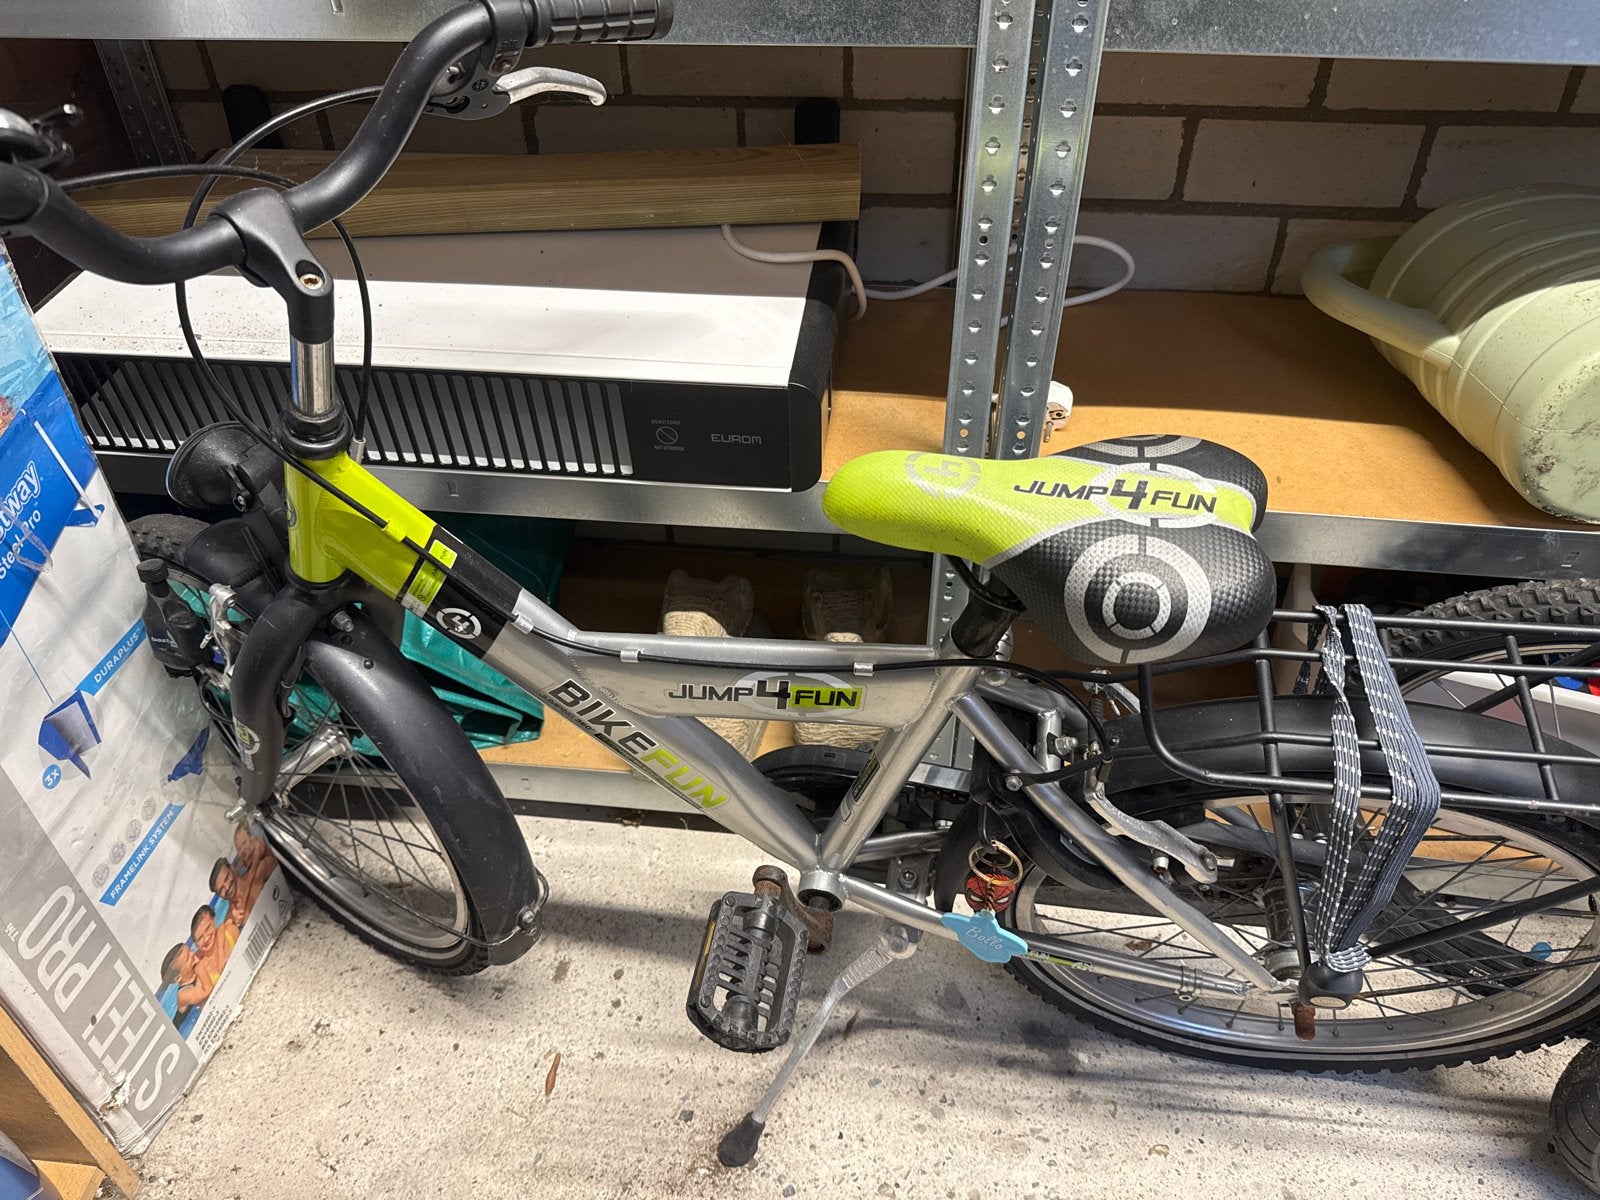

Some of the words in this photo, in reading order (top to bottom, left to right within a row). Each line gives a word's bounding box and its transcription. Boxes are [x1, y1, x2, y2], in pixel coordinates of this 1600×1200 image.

[711, 433, 762, 445] EUROM
[110, 845, 150, 899] FRAMELINK
[17, 885, 113, 1013] PRO
